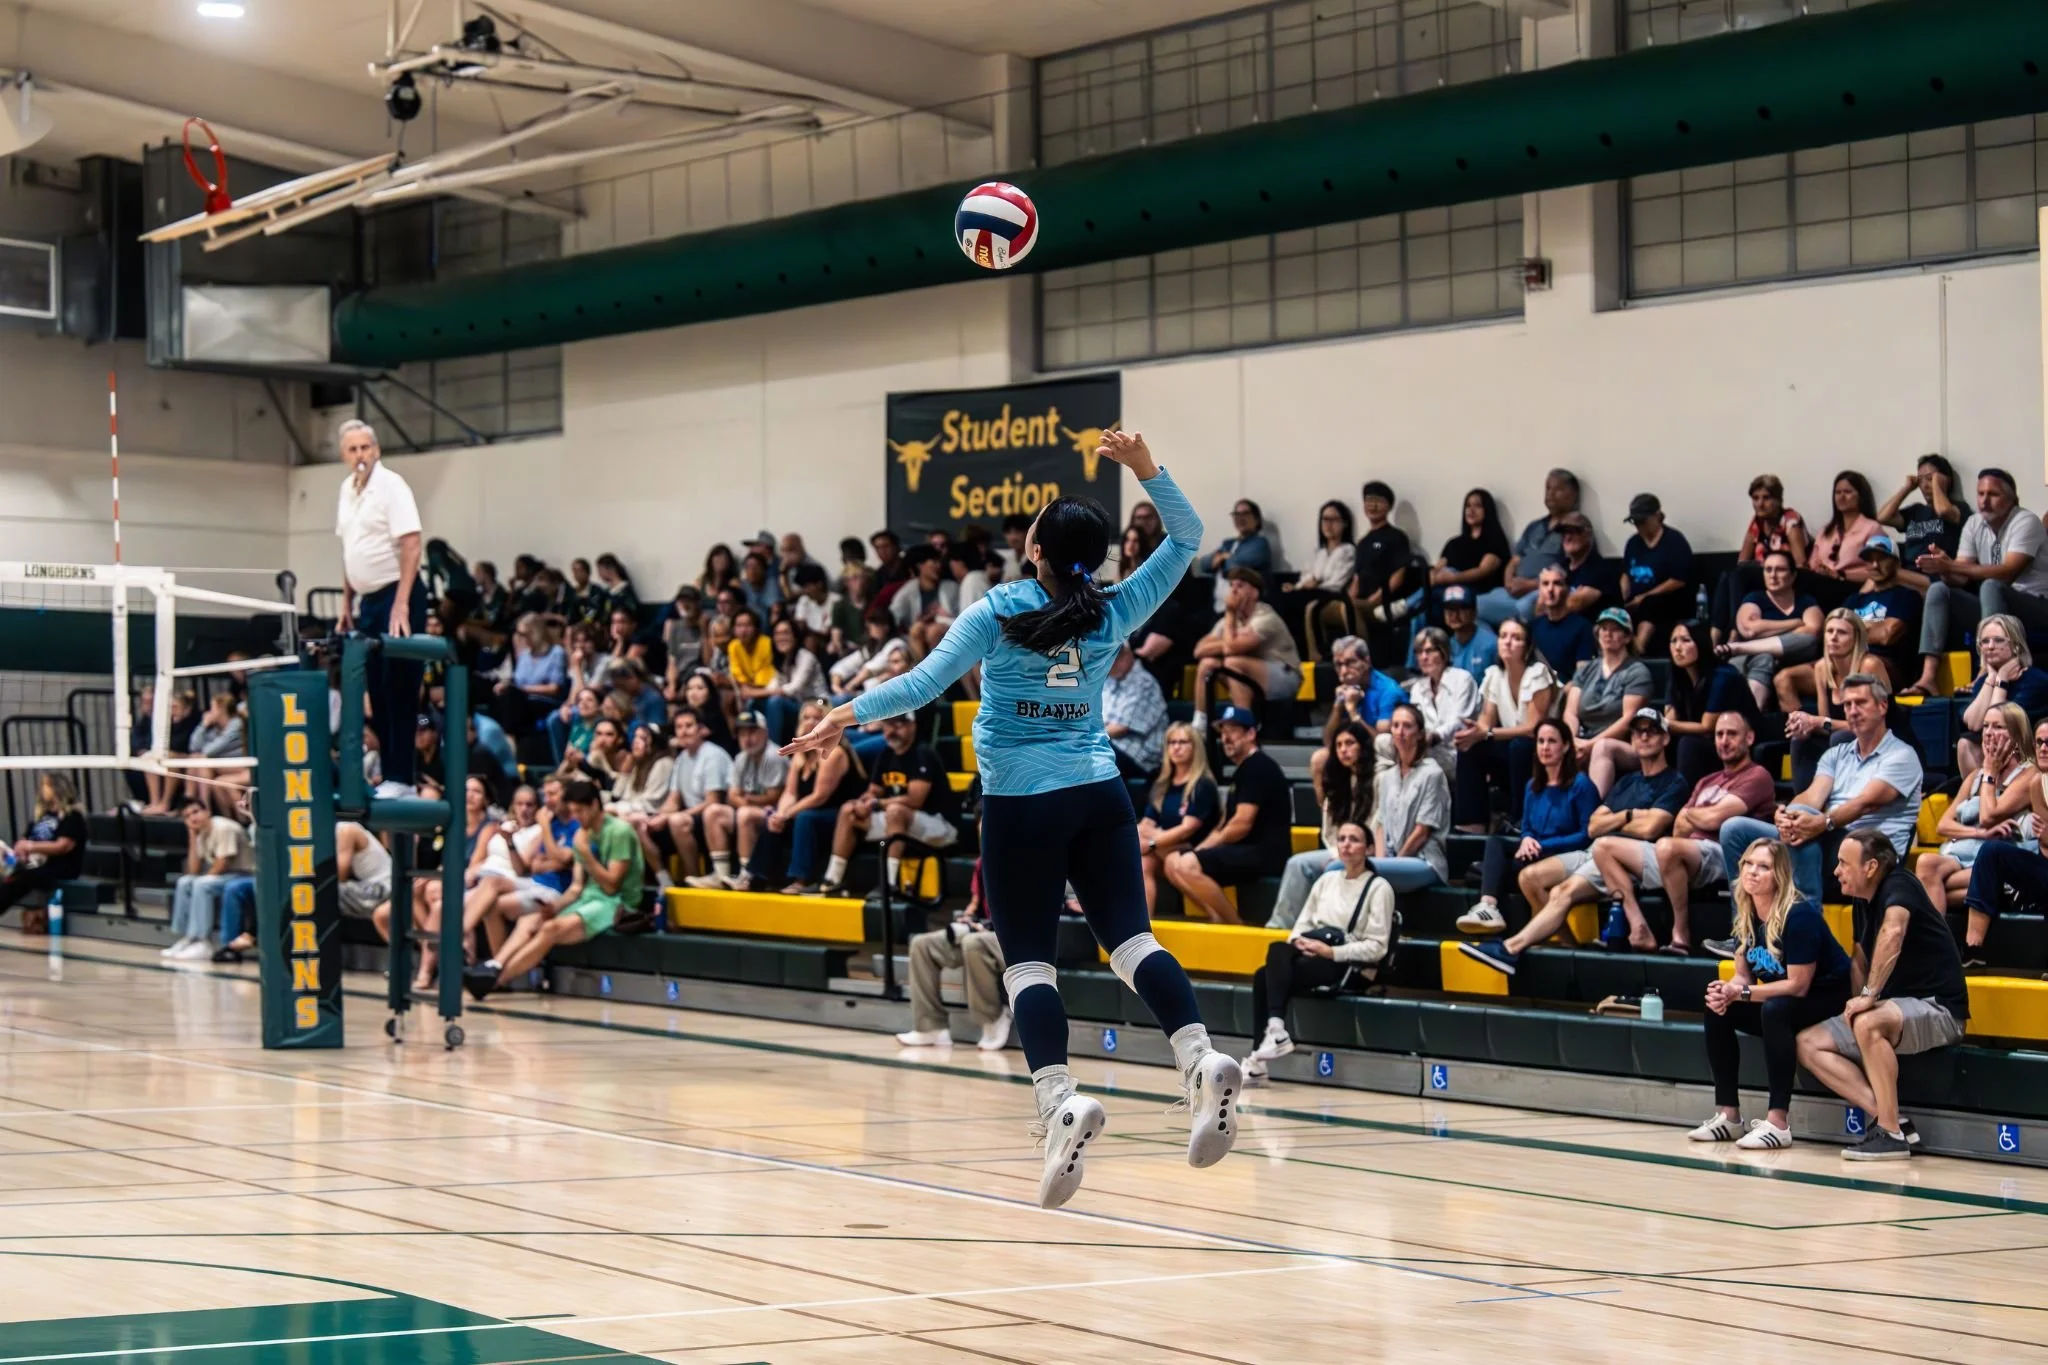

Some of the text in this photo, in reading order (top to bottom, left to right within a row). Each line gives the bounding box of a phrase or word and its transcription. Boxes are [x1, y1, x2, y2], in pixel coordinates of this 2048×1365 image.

[942, 403, 1060, 453] Student
[949, 472, 1060, 519] Section
[24, 563, 96, 580] LONGHORNS
[1045, 640, 1081, 688] 2
[281, 693, 321, 1029] LONGHORNS
